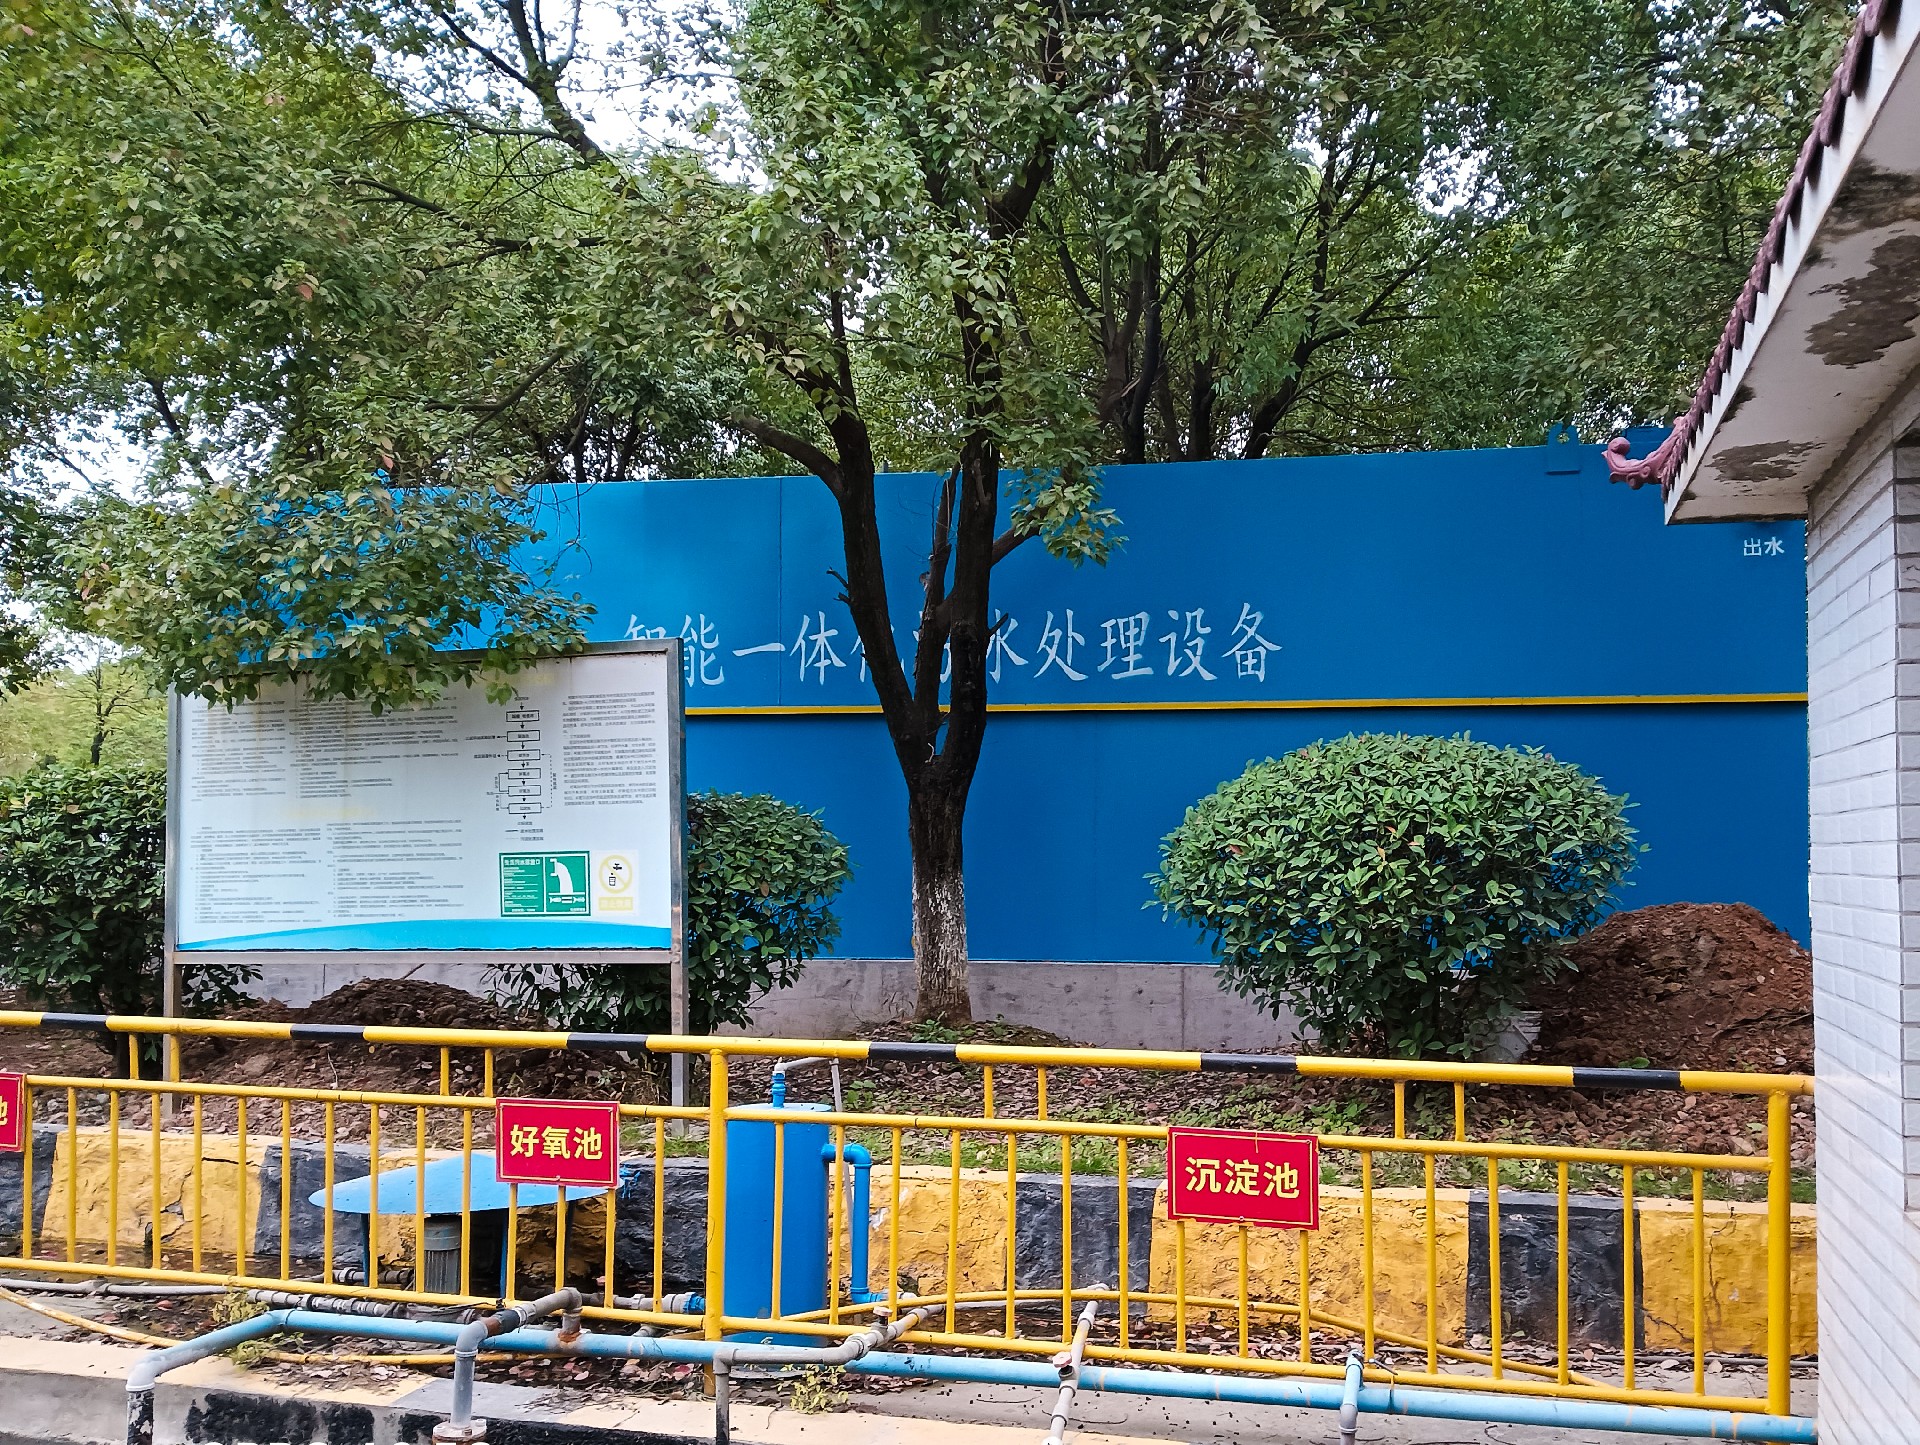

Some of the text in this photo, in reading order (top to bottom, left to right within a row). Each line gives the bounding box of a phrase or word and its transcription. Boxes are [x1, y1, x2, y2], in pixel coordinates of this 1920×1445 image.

[1743, 536, 1785, 556] 出水
[623, 602, 1283, 688] 能一体水处理设备
[510, 1124, 603, 1160] 好氧池
[1184, 1156, 1300, 1199] 沉淀池
